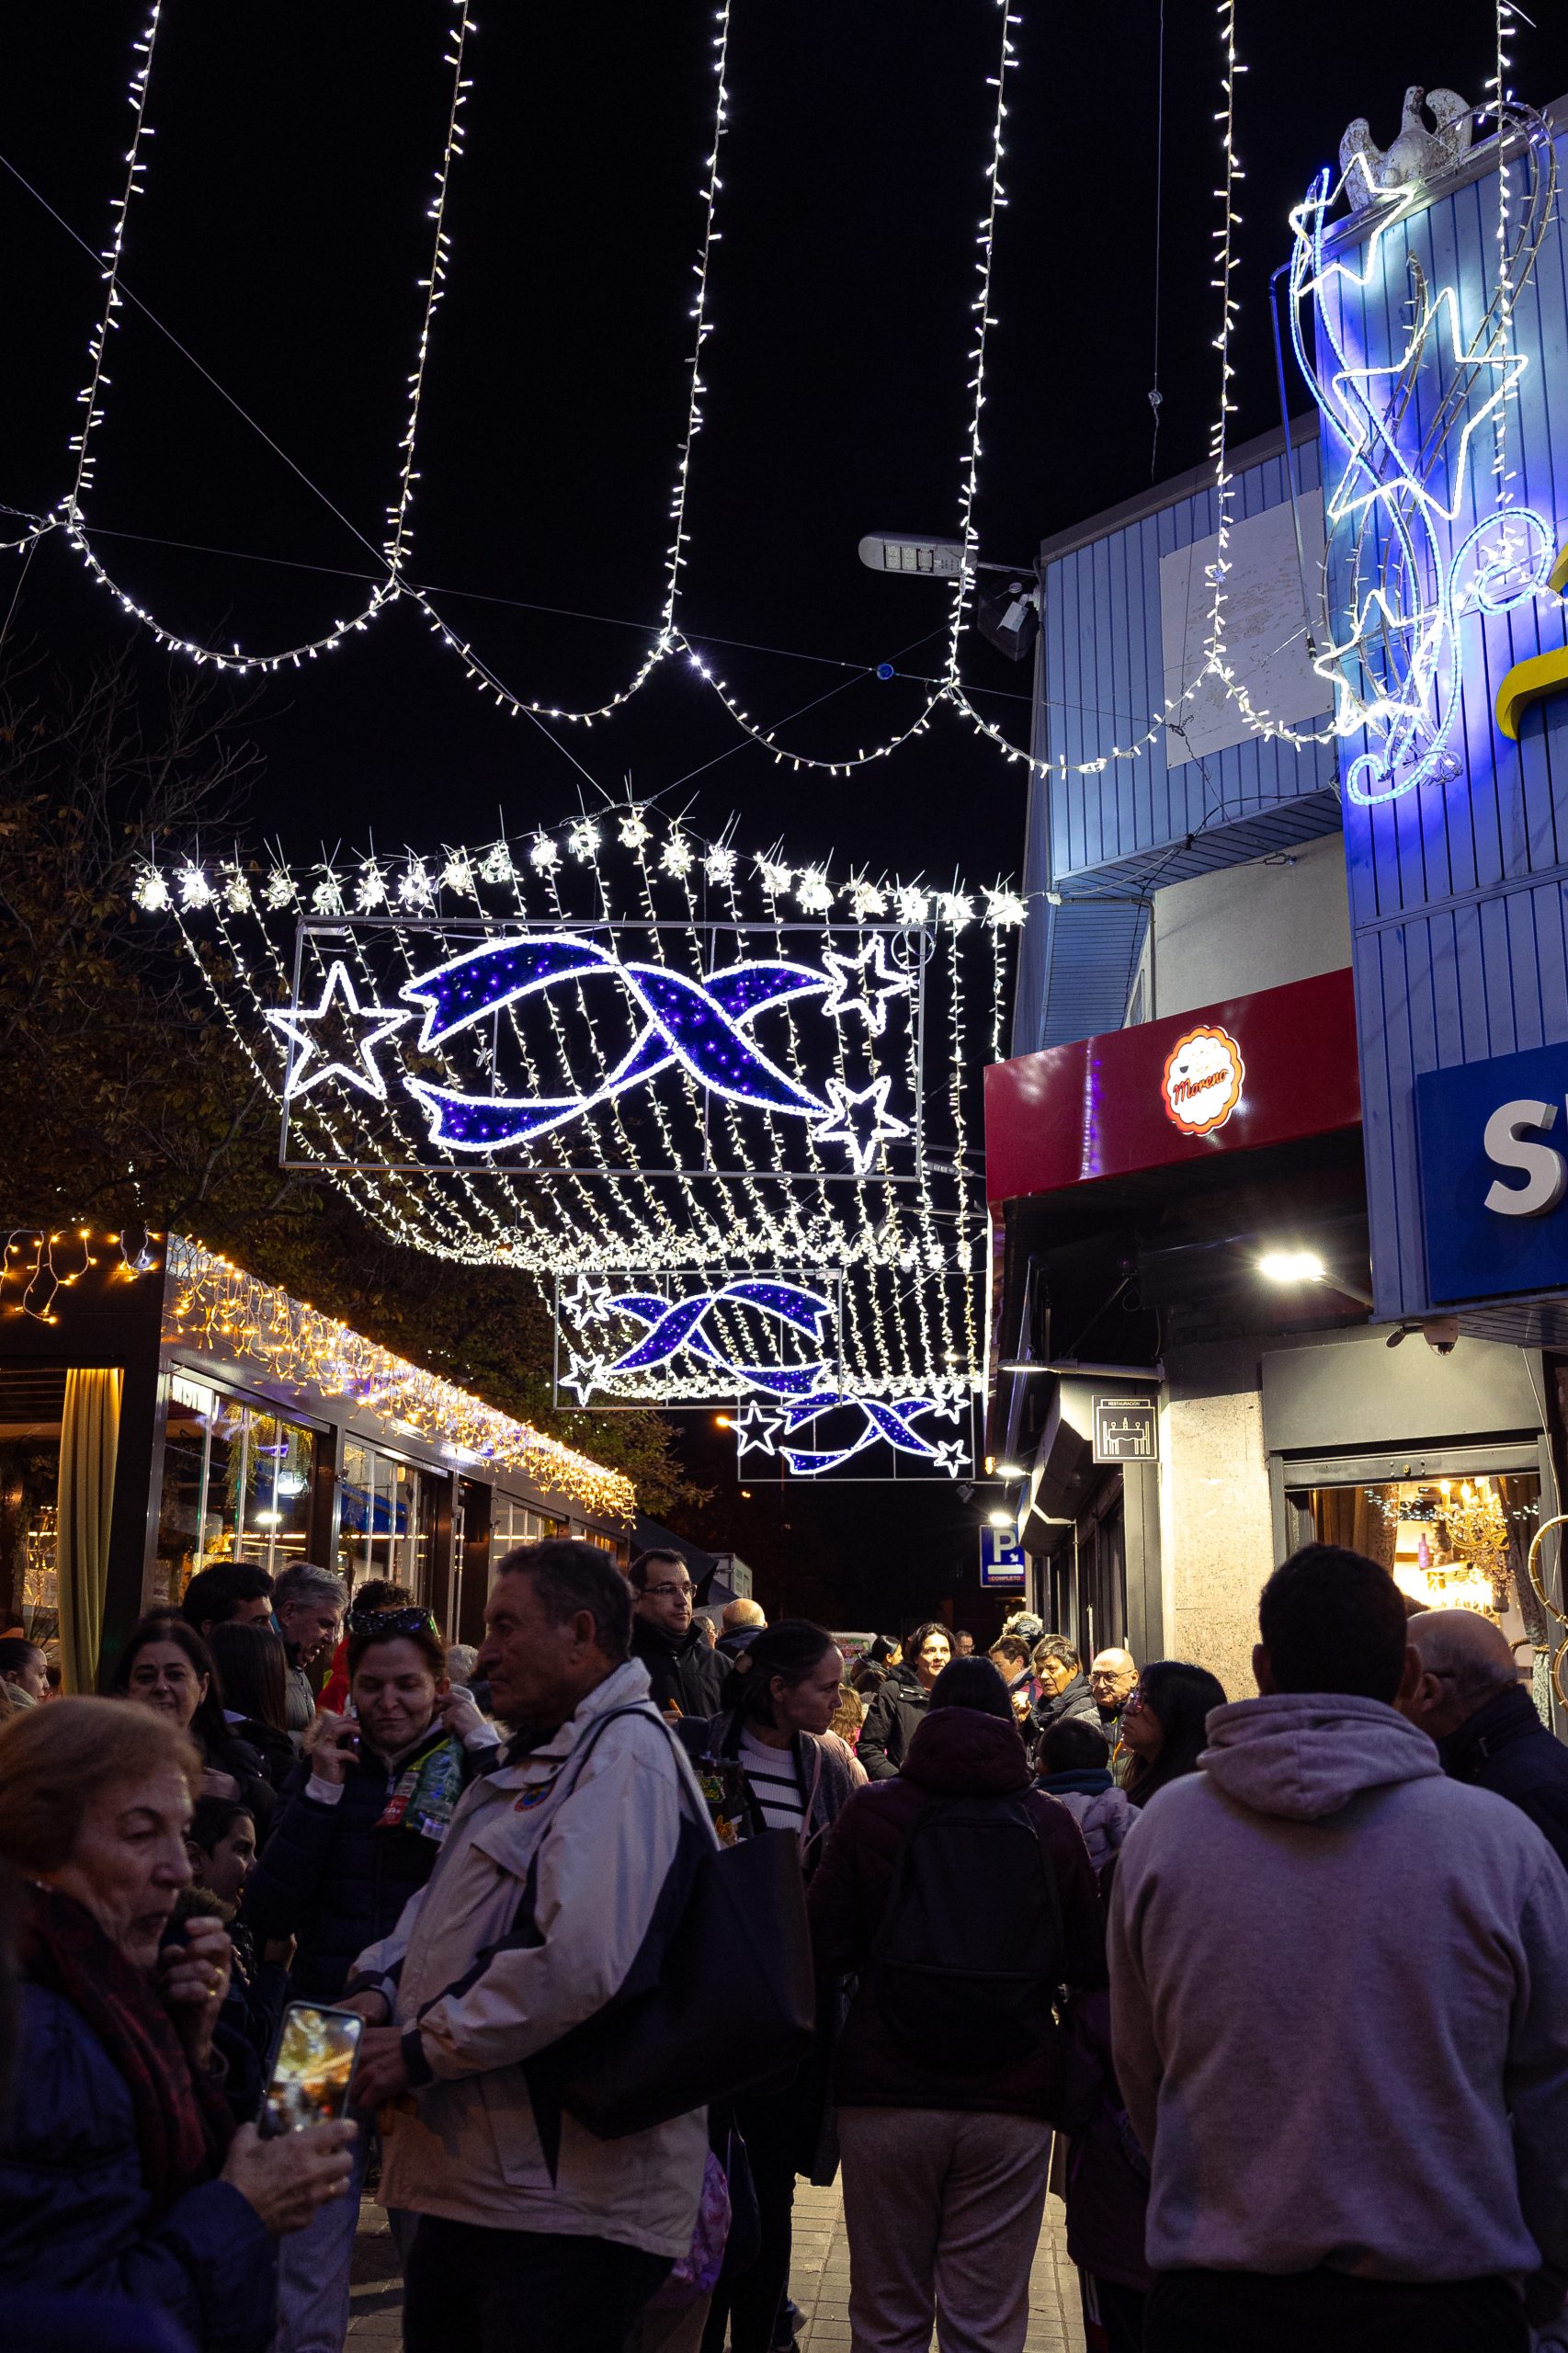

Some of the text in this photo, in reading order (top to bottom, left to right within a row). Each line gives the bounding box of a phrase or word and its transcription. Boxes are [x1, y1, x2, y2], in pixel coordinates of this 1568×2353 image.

[1173, 1069, 1229, 1105] Moreno
[1483, 1094, 1568, 1217] S
[993, 1529, 1017, 1563] P
